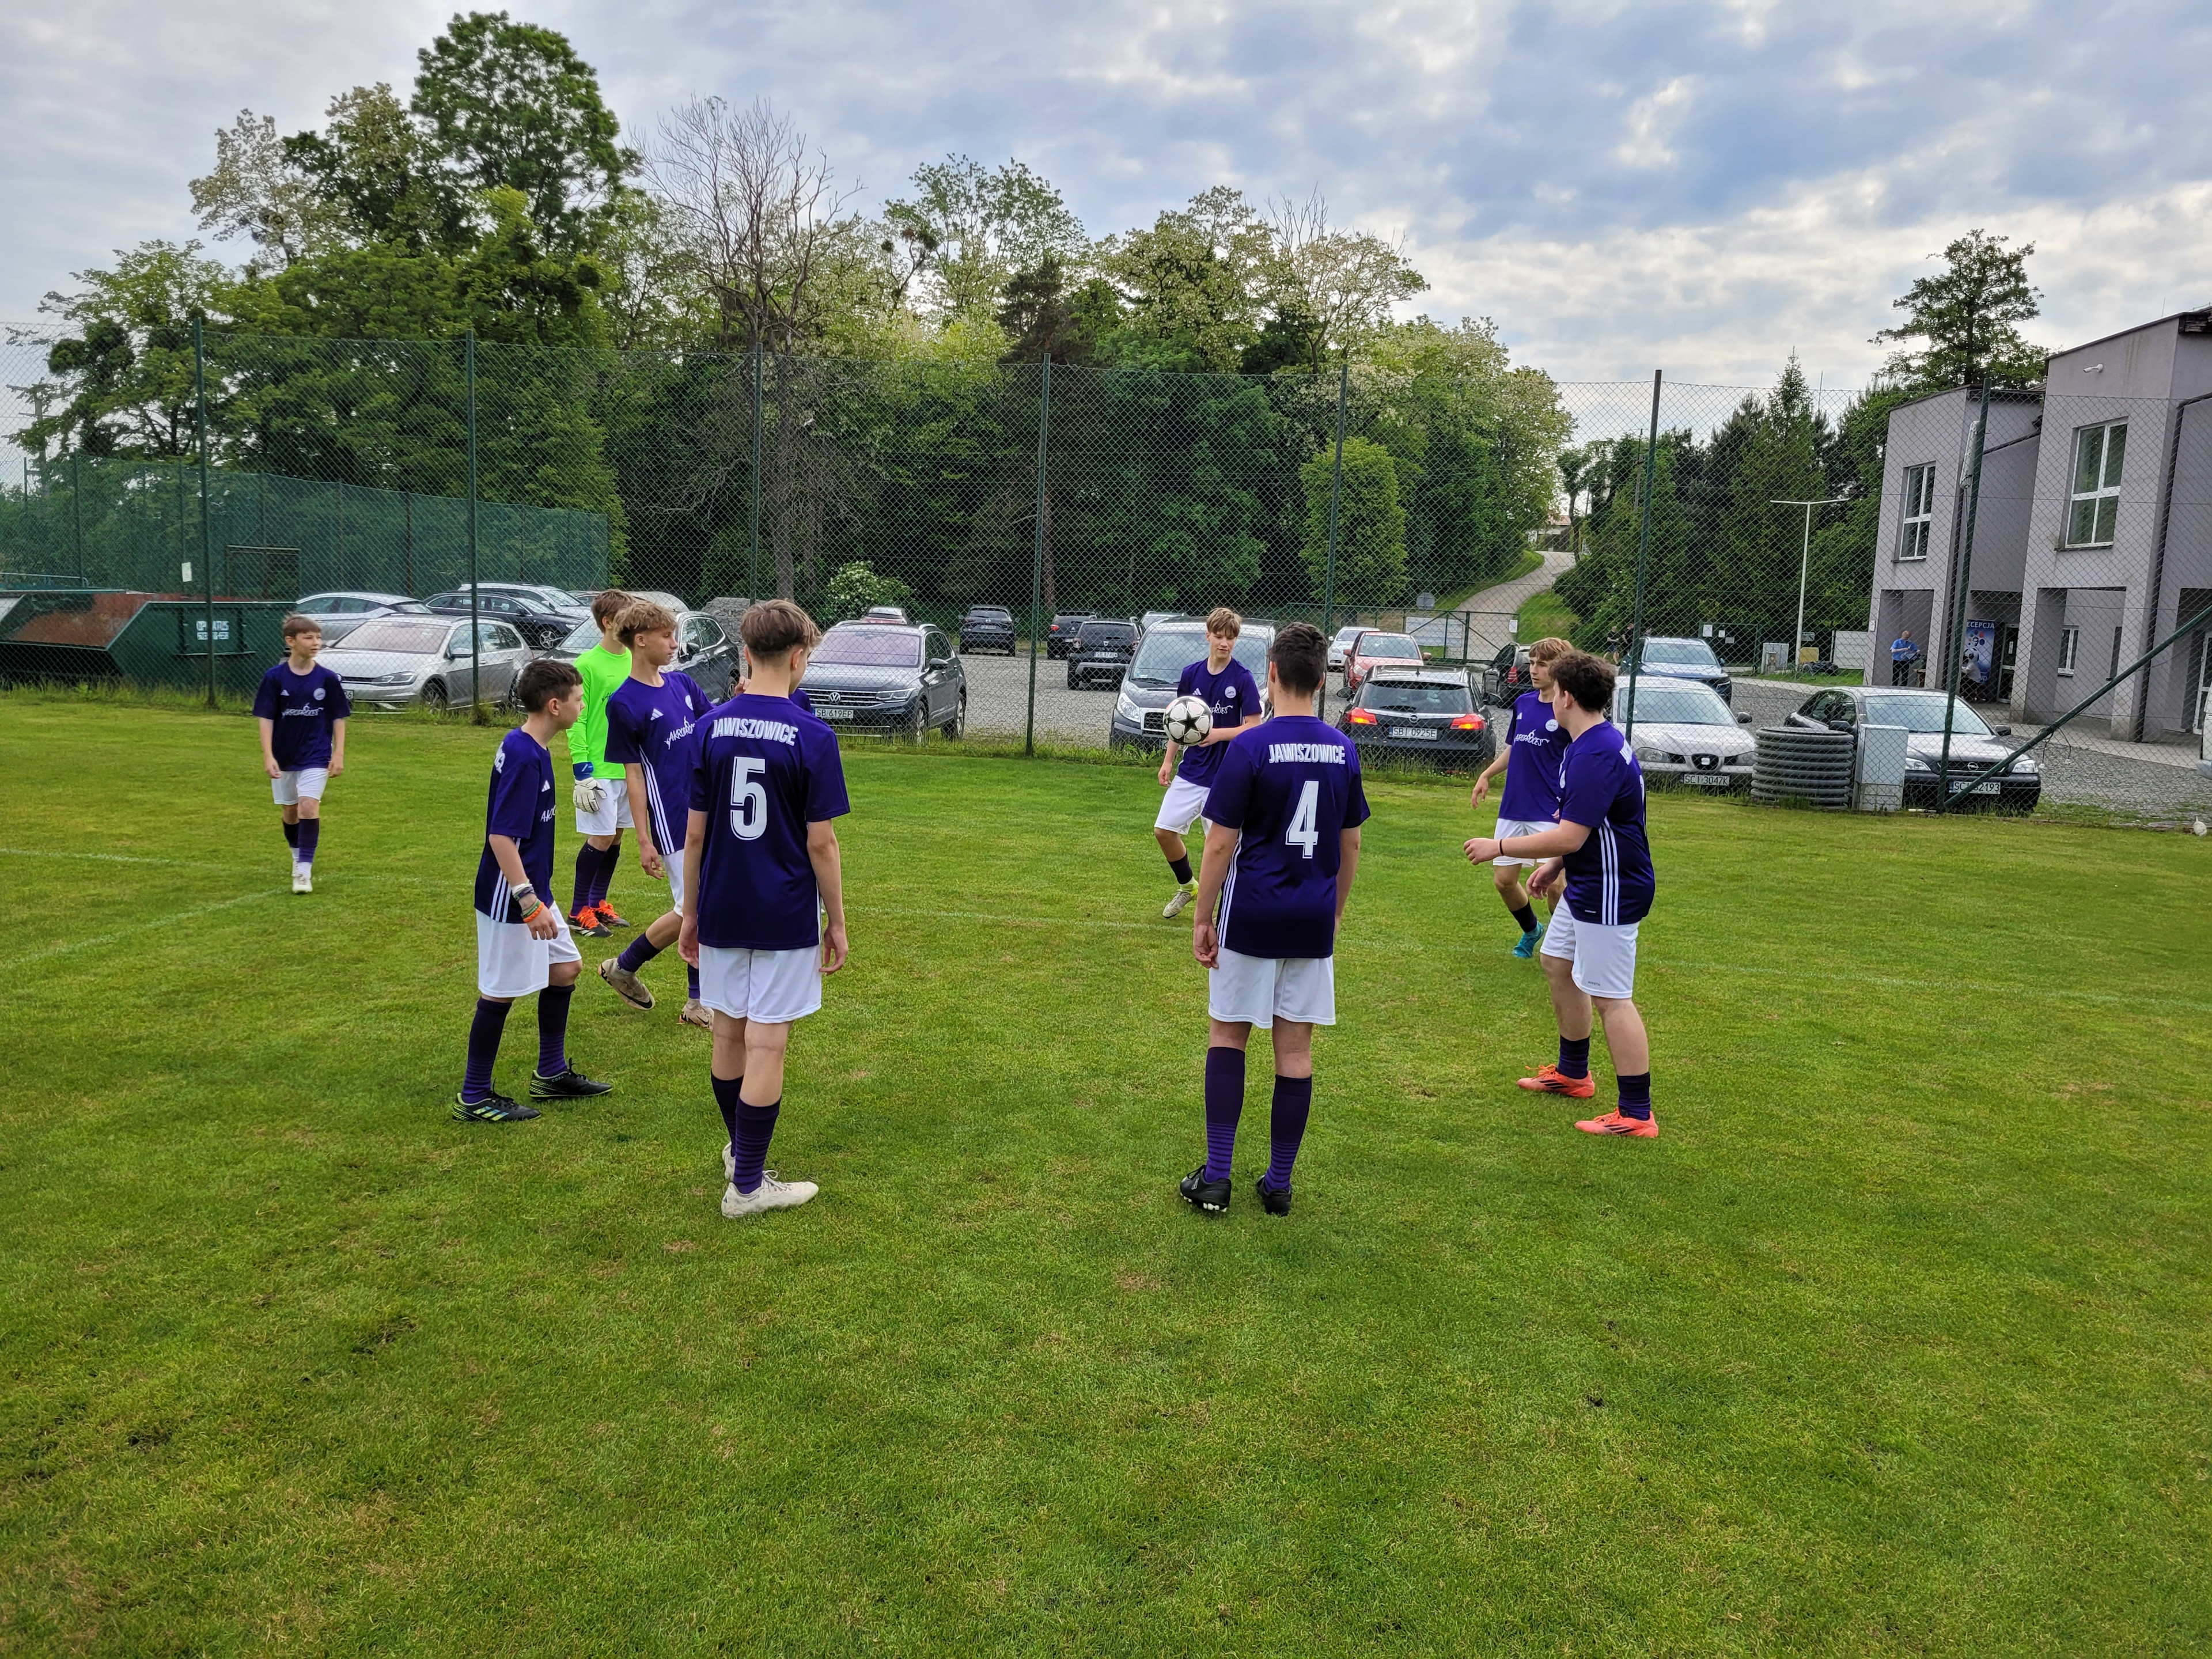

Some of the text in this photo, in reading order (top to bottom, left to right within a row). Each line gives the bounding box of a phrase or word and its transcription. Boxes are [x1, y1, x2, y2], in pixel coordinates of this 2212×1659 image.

[829, 709, 853, 718] 619EP
[711, 718, 798, 746] JAWISZOWICE
[1394, 728, 1436, 738] SBI 0925E
[1268, 743, 1346, 764] JAWISZOWICE
[1703, 776, 1728, 785] 3047K
[730, 756, 767, 840] 5
[1285, 781, 1319, 859] 4
